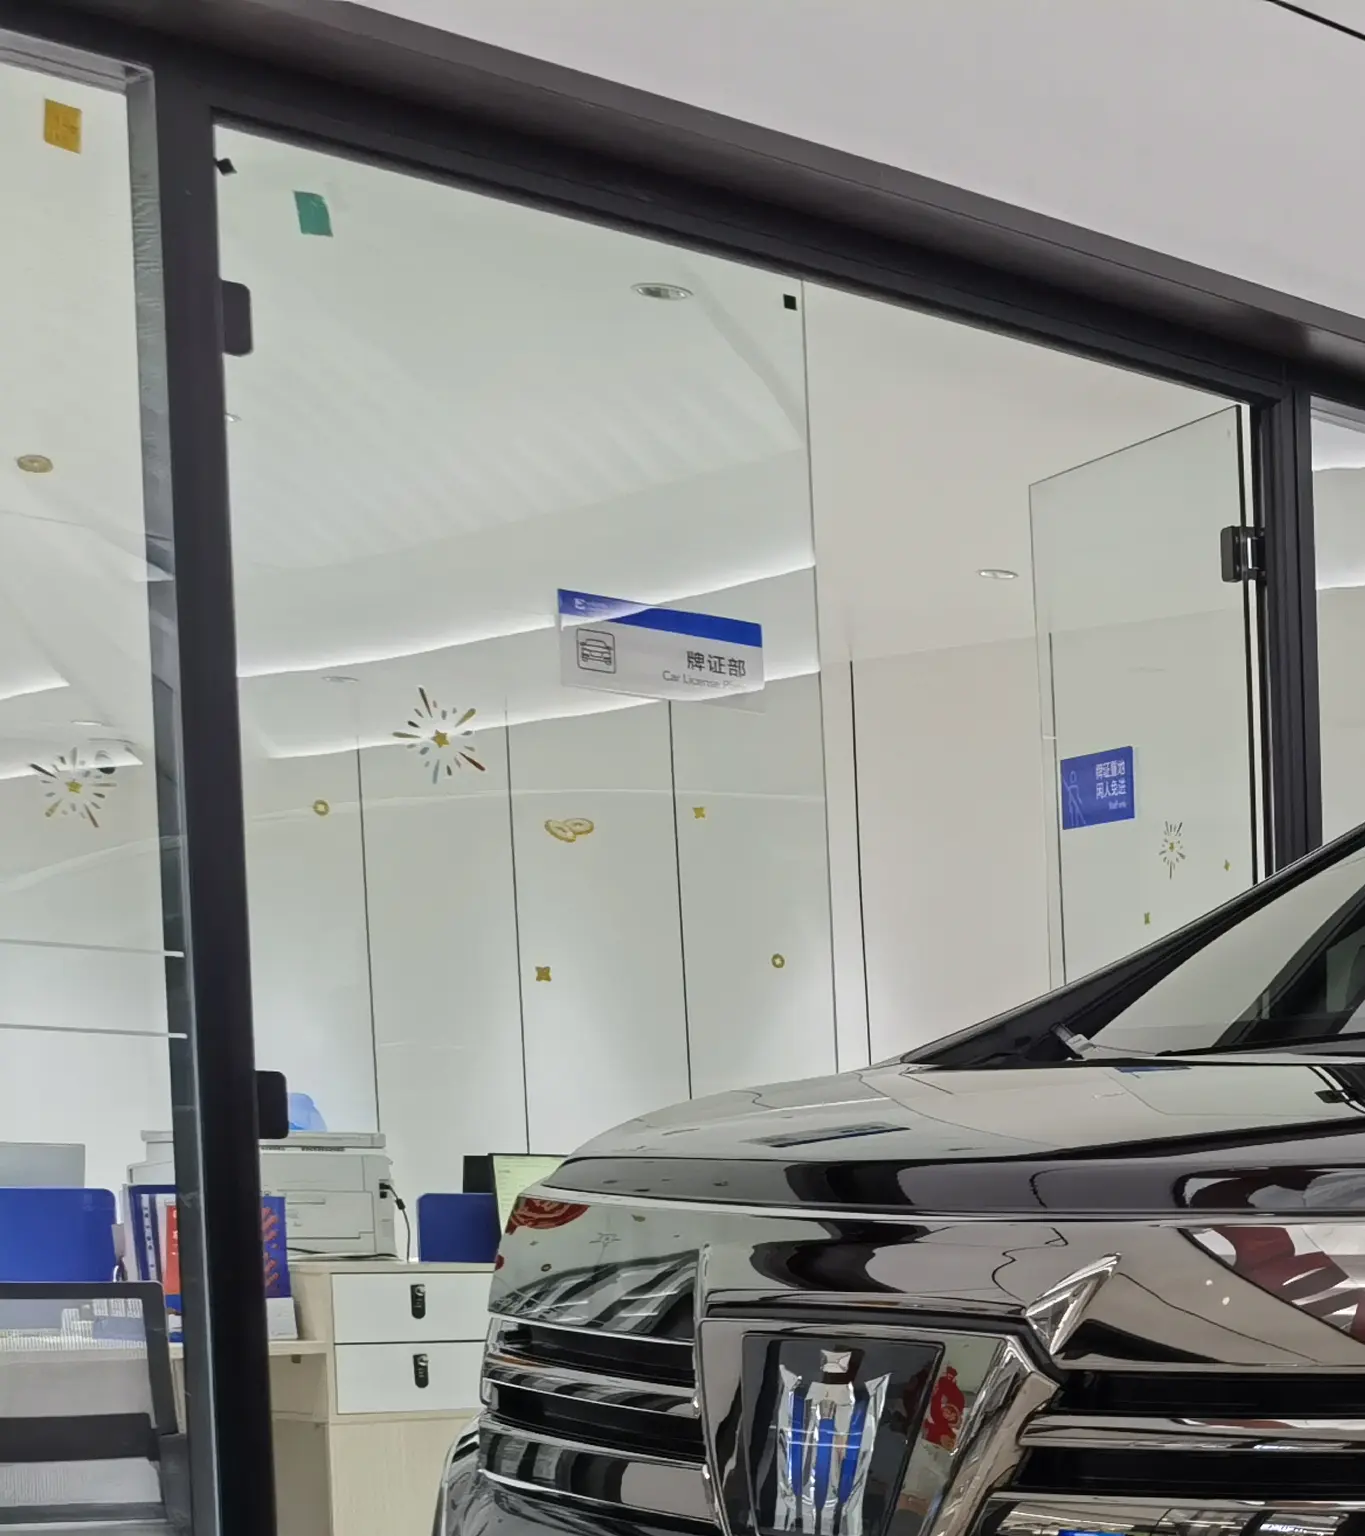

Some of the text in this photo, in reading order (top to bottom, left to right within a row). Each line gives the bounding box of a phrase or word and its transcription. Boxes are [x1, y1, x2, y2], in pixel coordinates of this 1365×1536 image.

[685, 650, 747, 679] 牌证部
[662, 670, 681, 683] Car
